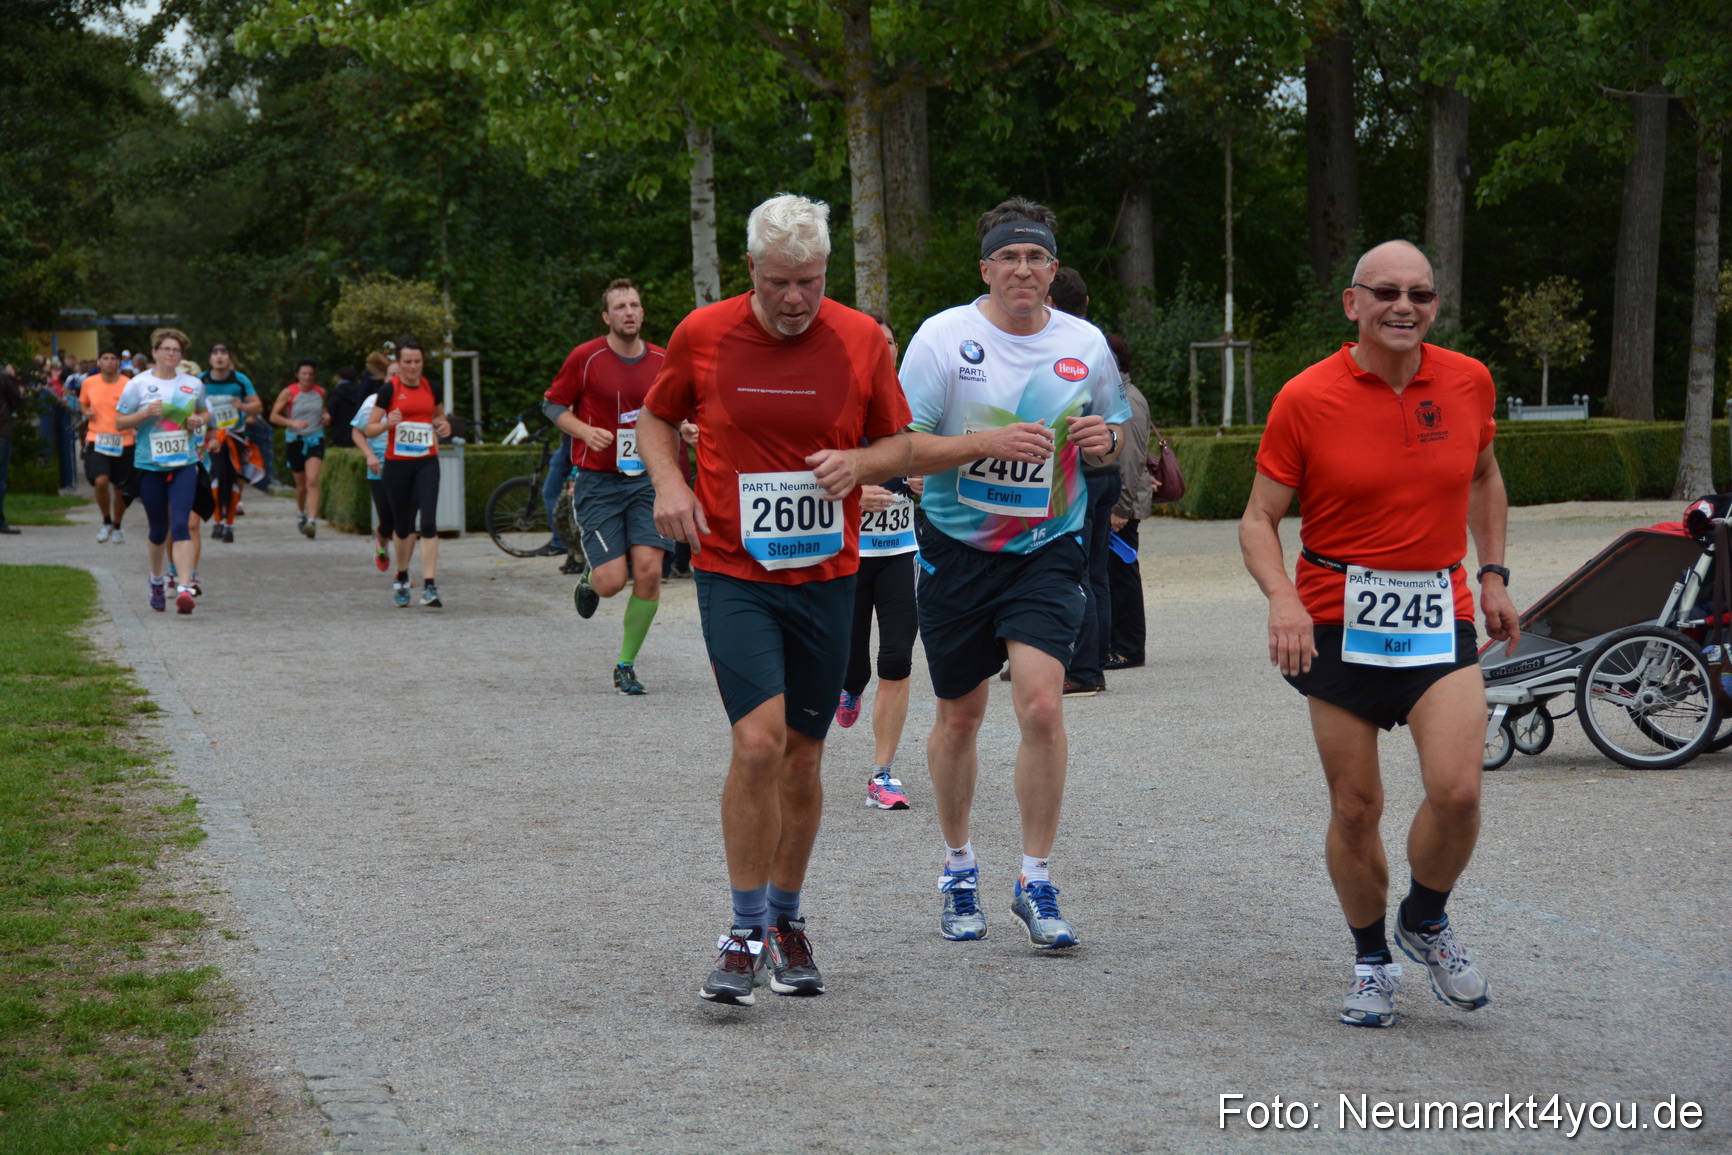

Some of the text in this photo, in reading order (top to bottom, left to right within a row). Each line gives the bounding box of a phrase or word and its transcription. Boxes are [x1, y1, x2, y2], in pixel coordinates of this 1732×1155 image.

[959, 367, 986, 378] PARTL
[1058, 363, 1085, 376] Hervis
[399, 429, 429, 444] 2041
[155, 439, 186, 454] 3037
[968, 455, 1045, 483] 2402
[742, 482, 821, 492] PARTL Neumar
[987, 488, 1022, 504] Erwin
[752, 495, 834, 532] 2600
[860, 506, 910, 532] 2438
[767, 540, 820, 557] Stephan
[871, 538, 900, 547] Verena
[1349, 574, 1436, 588] PARTL Neumarkt
[1356, 590, 1443, 628] 2245
[1384, 638, 1412, 653] Karl
[1492, 659, 1541, 677] chariot
